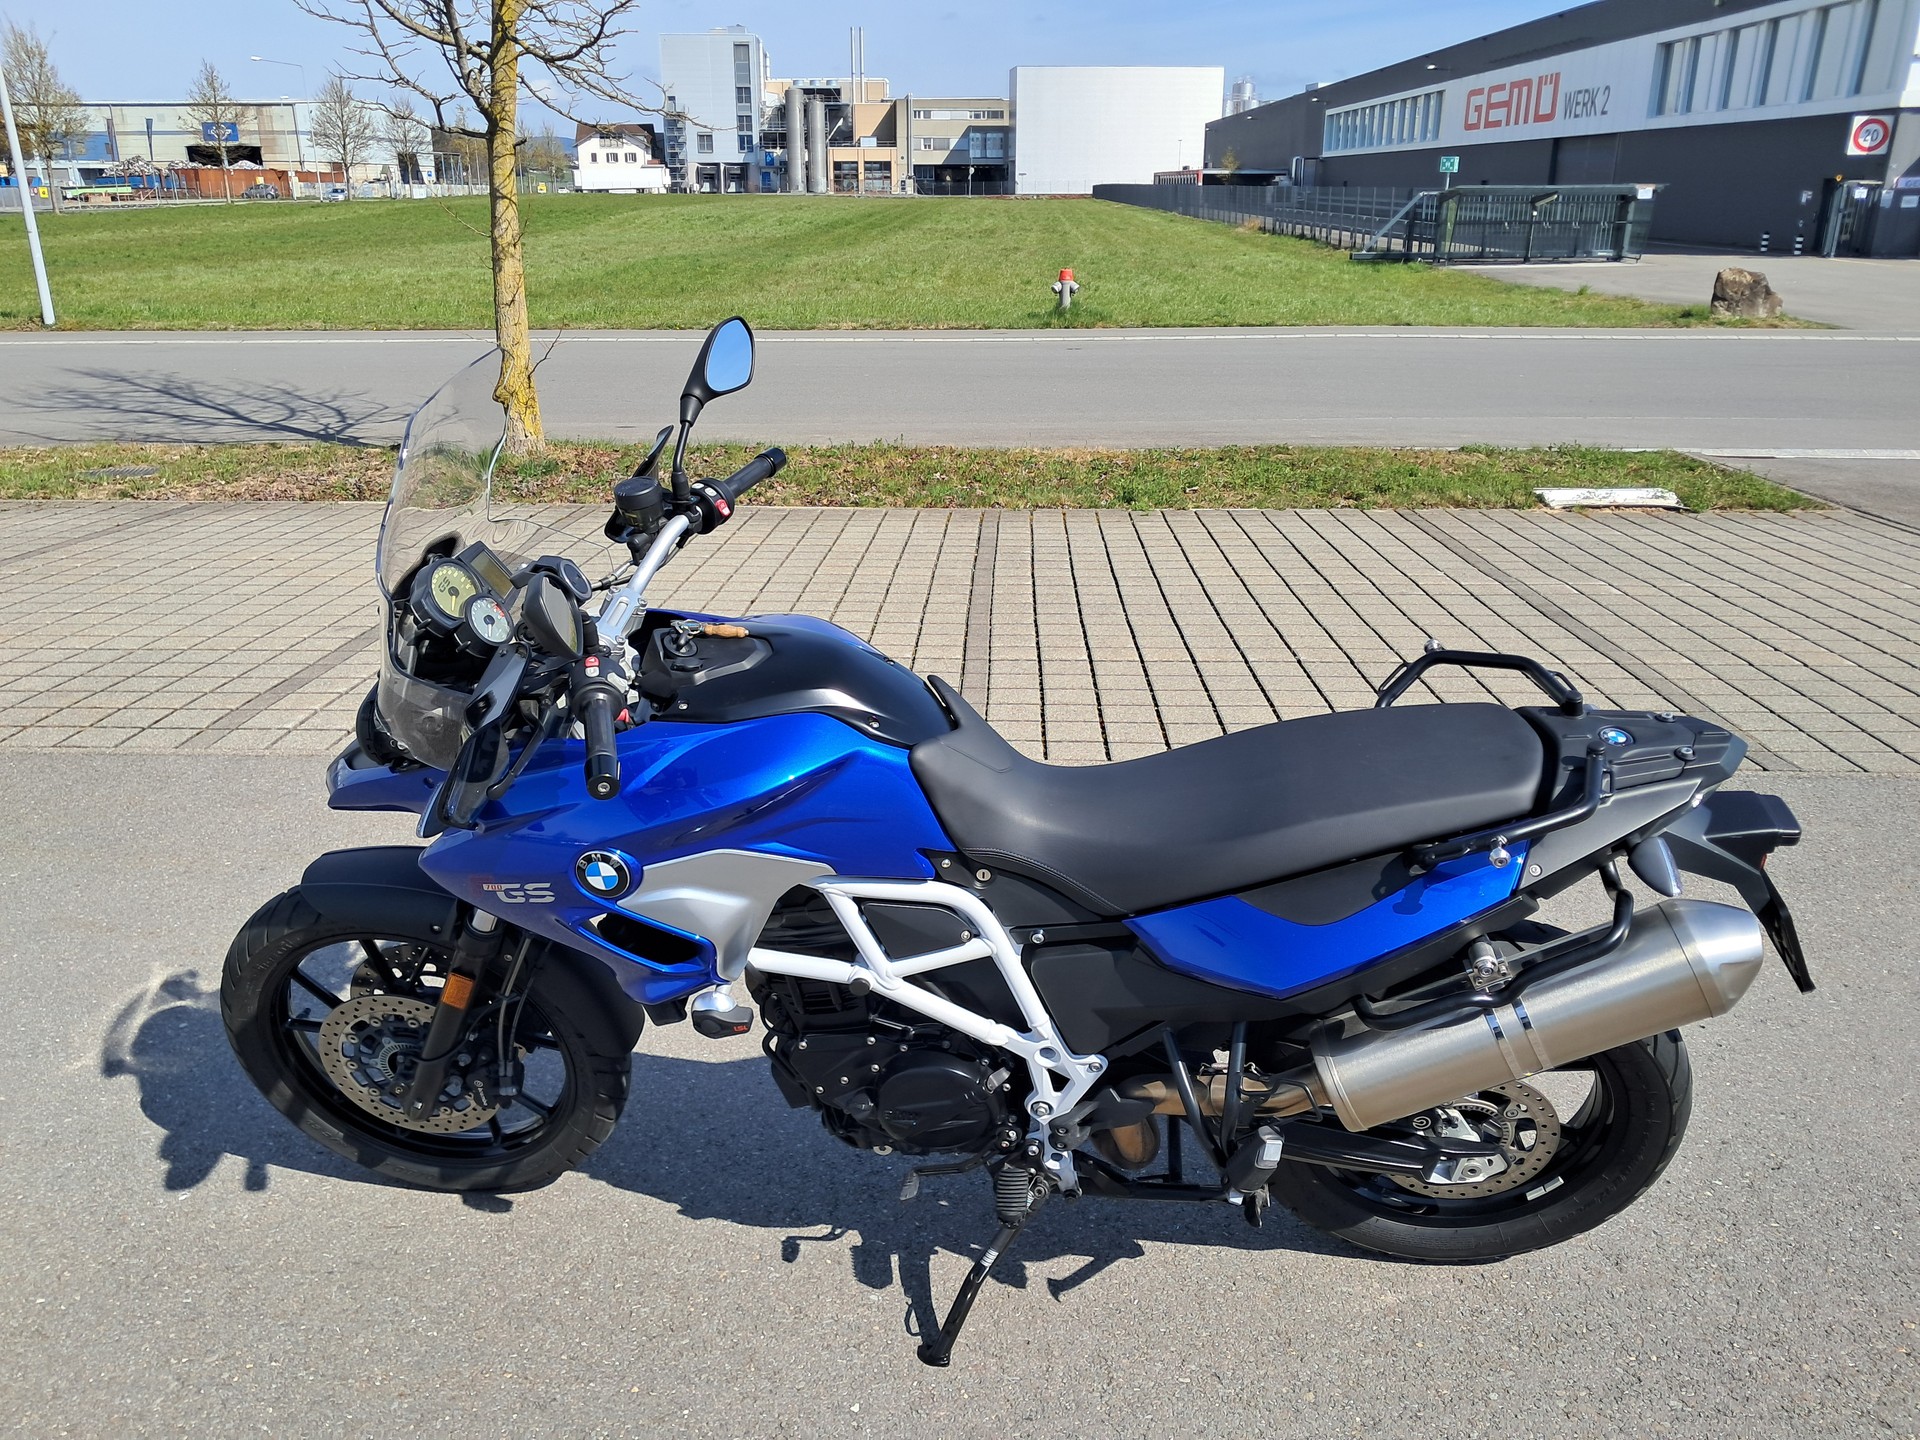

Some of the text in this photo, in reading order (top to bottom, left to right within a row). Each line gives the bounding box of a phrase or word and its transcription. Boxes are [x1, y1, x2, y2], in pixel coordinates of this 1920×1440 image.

[1464, 72, 1611, 131] GEMÜ WERK 2
[1863, 129, 1879, 142] 20
[578, 853, 621, 869] BMW
[483, 883, 556, 903] GS
